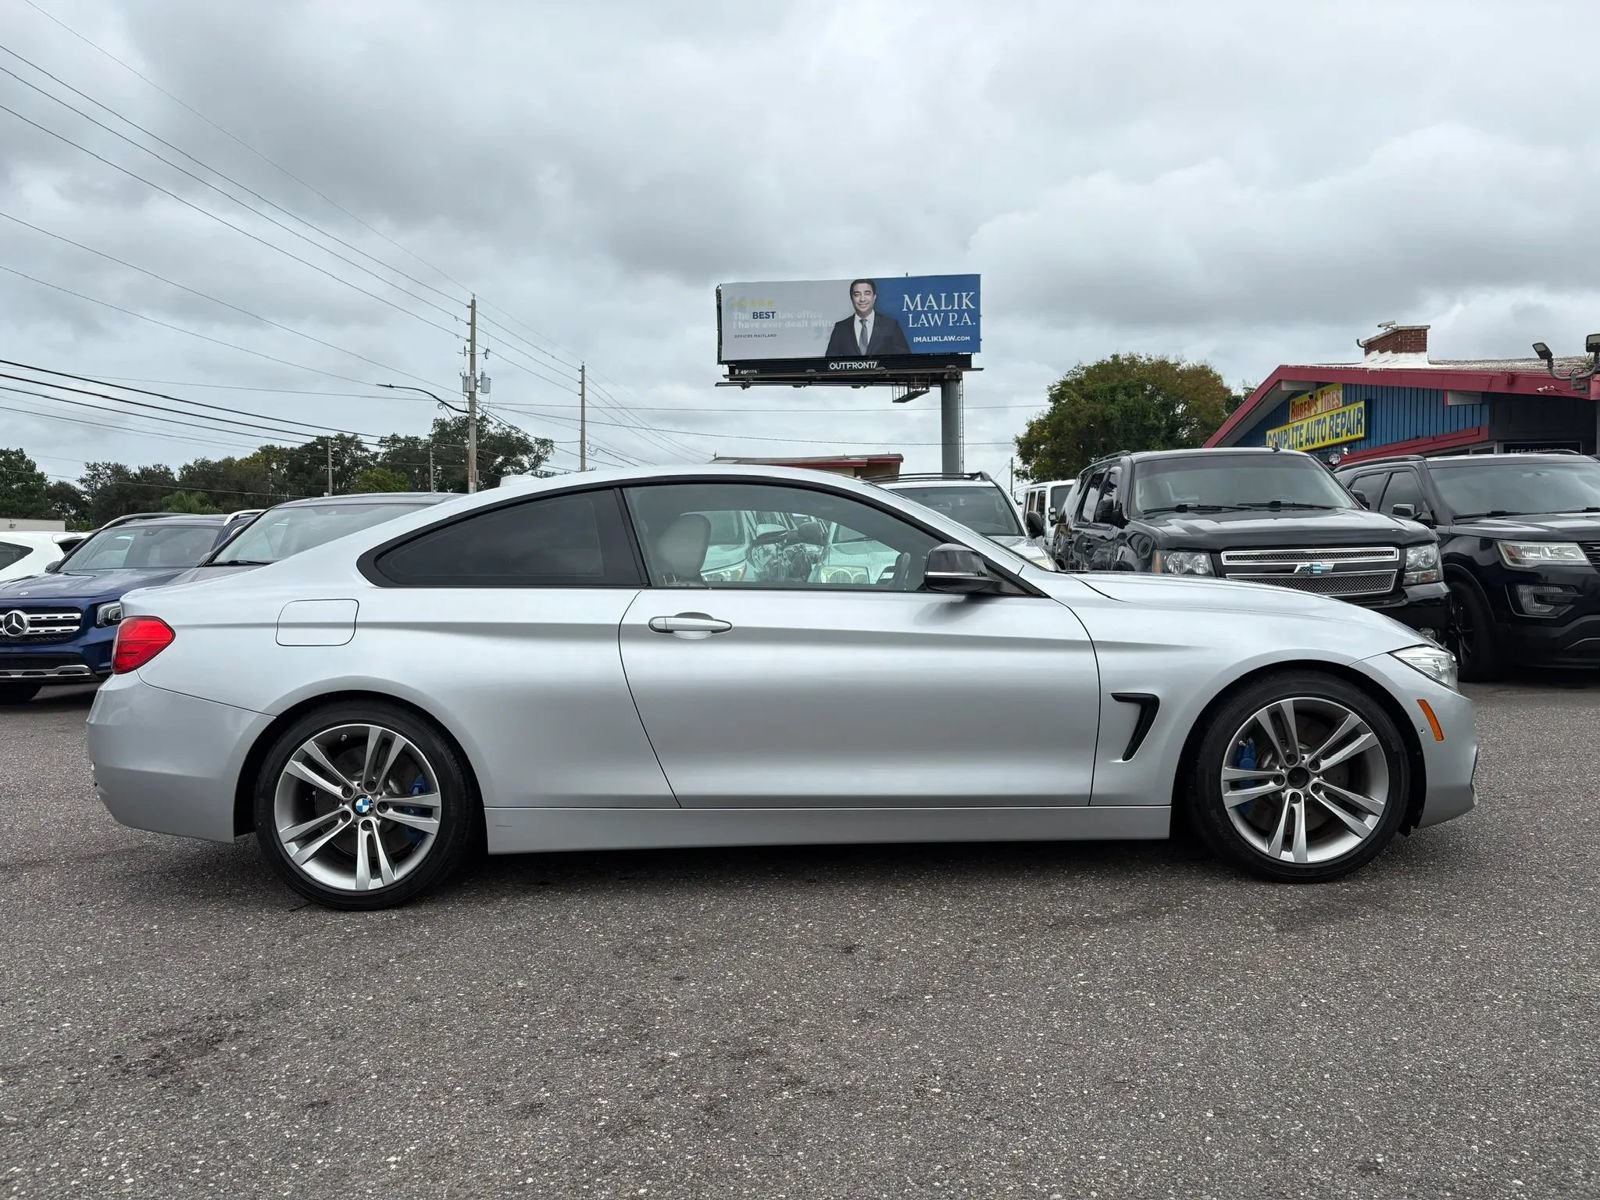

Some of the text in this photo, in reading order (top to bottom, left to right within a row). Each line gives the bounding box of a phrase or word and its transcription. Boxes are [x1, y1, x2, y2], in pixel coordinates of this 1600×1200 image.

[902, 292, 976, 312] MALIK
[752, 311, 776, 320] BEST
[908, 312, 976, 328] LAW P.A.
[1320, 390, 1340, 411] TIRES
[1305, 418, 1326, 446] AUTO
[1329, 406, 1362, 440] REPAIR
